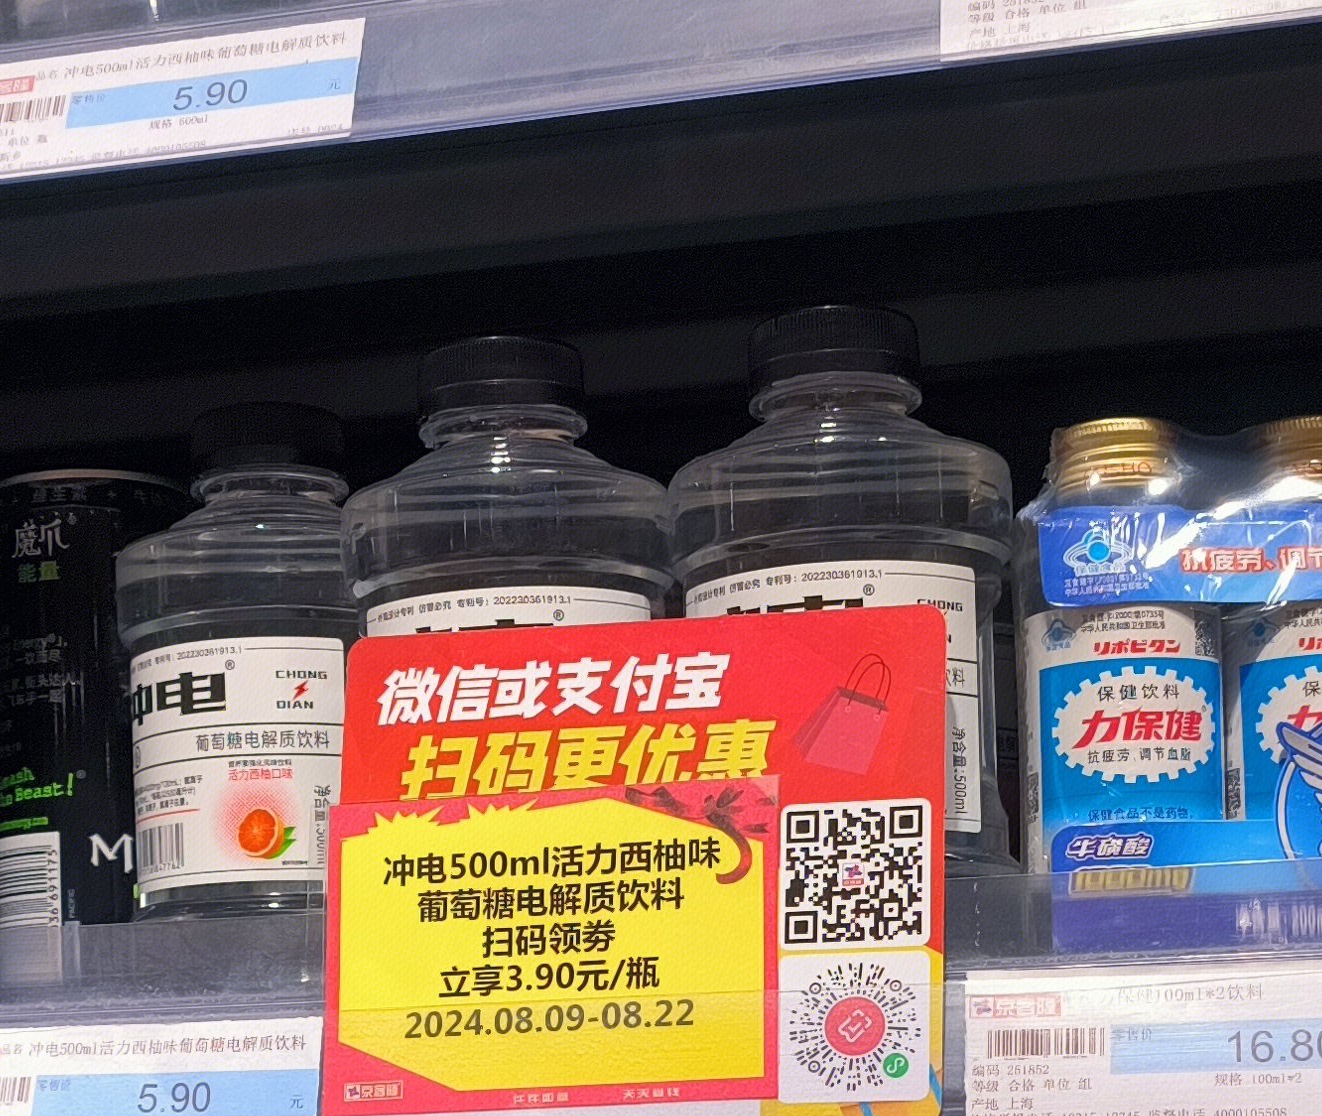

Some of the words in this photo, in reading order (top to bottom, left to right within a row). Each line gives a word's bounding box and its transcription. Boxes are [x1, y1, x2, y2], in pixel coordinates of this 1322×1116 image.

[172, 78, 248, 111] 5.90
[1093, 638, 1181, 655] リポビタン
[275, 669, 328, 681] CHONG
[376, 650, 732, 727] 微信或支付宝
[276, 699, 314, 710] DIAN
[1097, 682, 1180, 702] 保健饮料
[196, 729, 330, 753] 葡萄糖电解质饮料
[1072, 704, 1205, 750] 力保健
[399, 719, 777, 801] 扫码更优惠
[382, 836, 722, 886] 冲电500ml活力西柚味
[417, 876, 686, 922] 葡萄糖电解质饮料
[438, 955, 661, 998] 立享3.90元/瓶
[403, 998, 695, 1041] 2024.08.09-08.22
[136, 1081, 212, 1114] 5.90
[1007, 1078, 1036, 1092] 合格
[289, 1095, 304, 1109] 元
[1007, 1096, 1034, 1111] 上海
